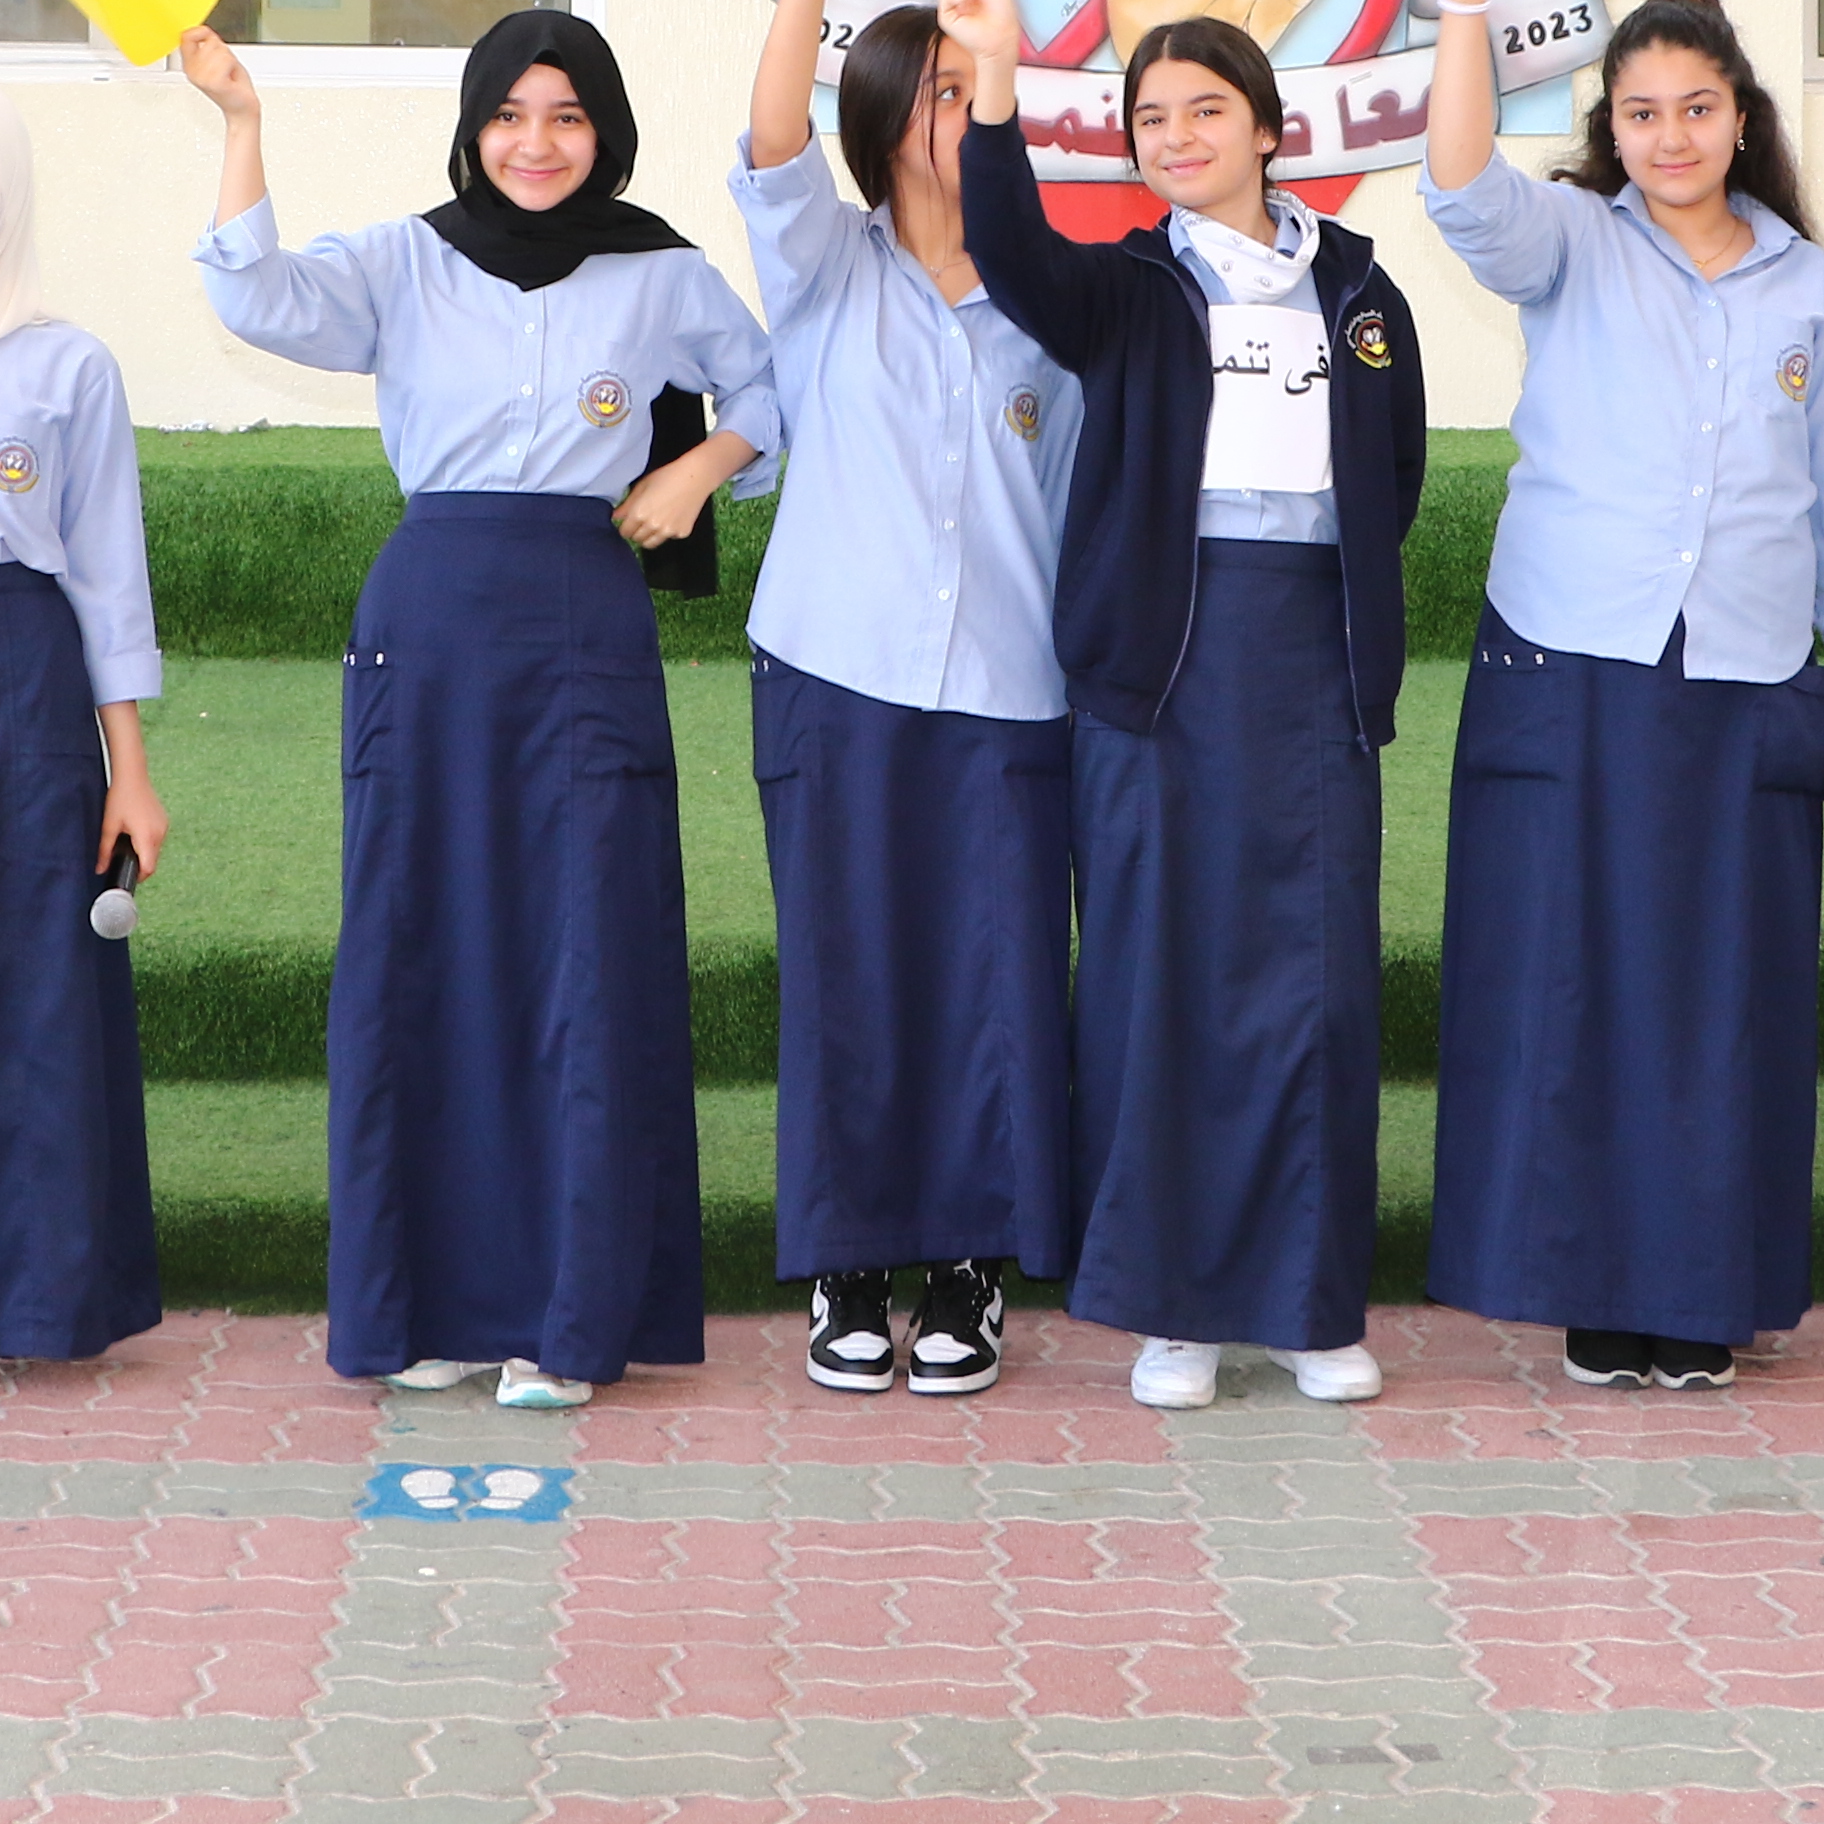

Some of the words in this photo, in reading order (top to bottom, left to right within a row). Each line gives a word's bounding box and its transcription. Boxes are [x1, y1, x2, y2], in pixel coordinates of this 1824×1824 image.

[1503, 3, 1594, 55] 2023
[1212, 339, 1270, 376] تنم
[1284, 342, 1331, 396] فى
